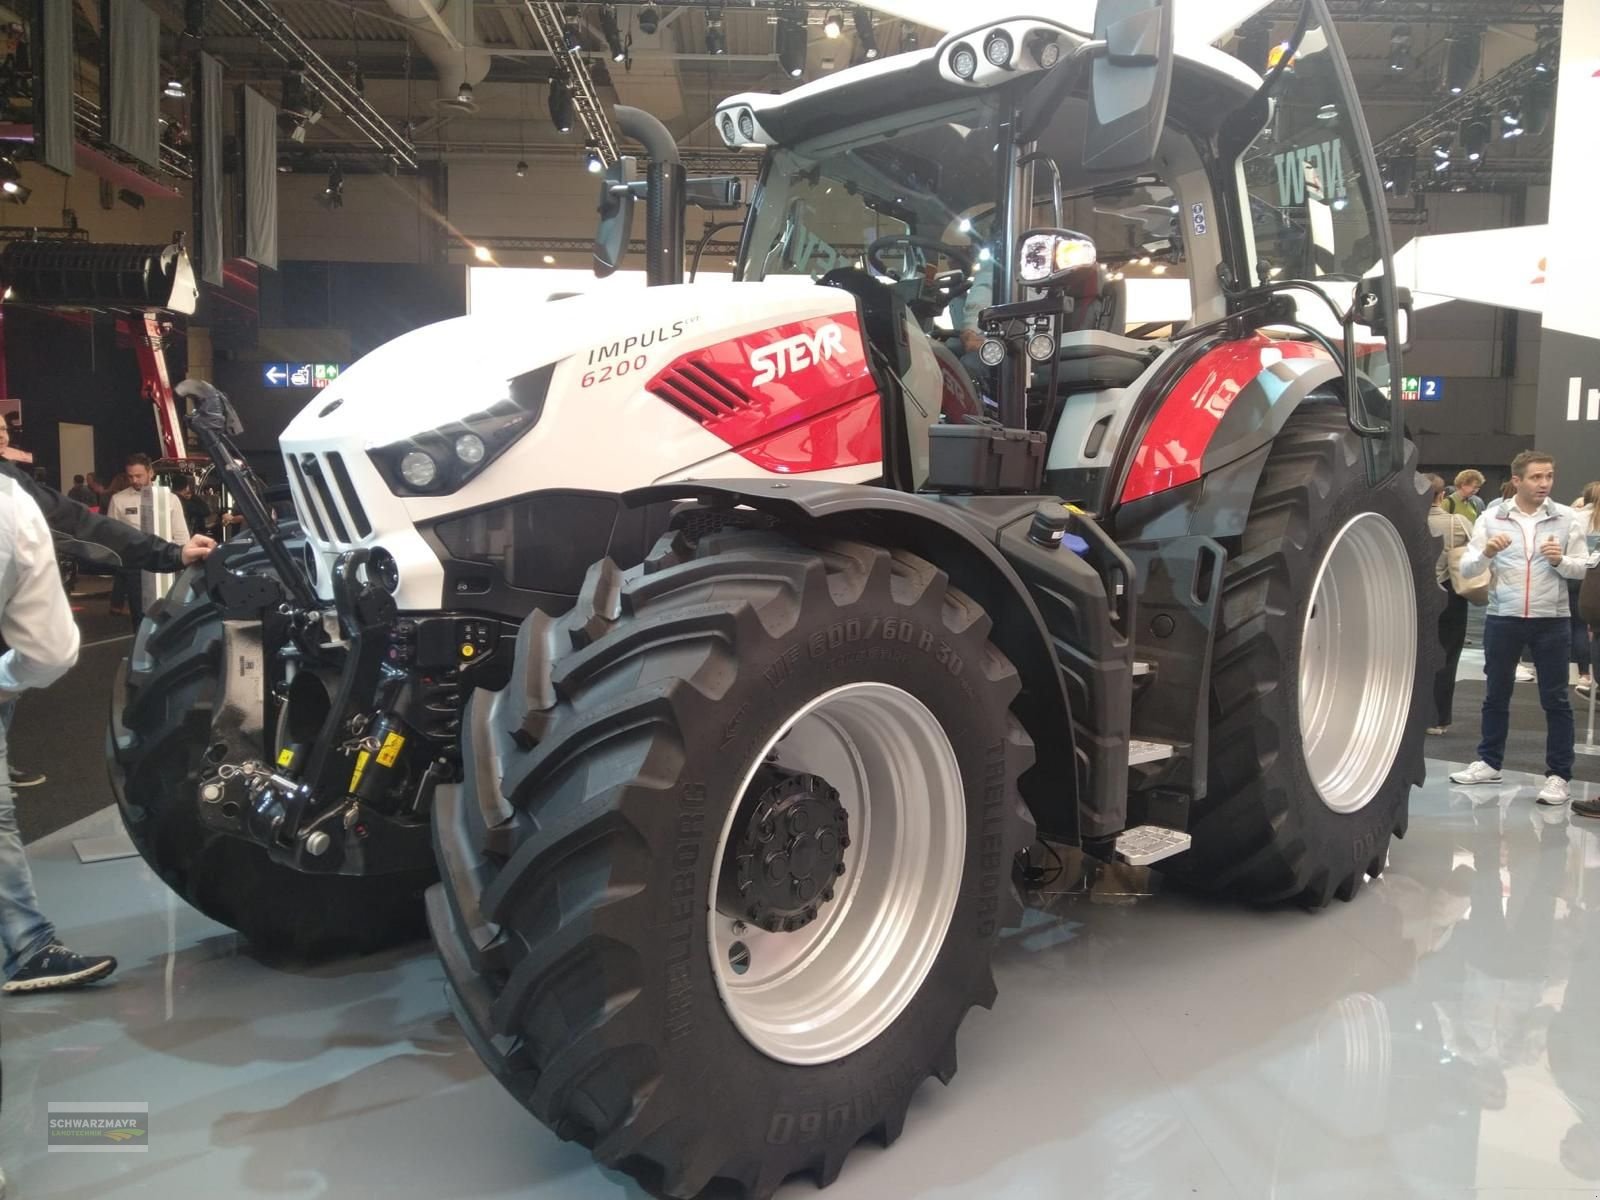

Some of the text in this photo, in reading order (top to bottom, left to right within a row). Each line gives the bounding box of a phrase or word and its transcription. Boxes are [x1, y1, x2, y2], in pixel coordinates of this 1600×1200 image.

[588, 321, 685, 366] IMPULS
[750, 322, 847, 388] STEYR
[581, 354, 648, 389] 6200
[1425, 381, 1436, 396] 2
[808, 615, 914, 658] 600/60
[918, 629, 935, 652] R
[935, 639, 964, 676] 30
